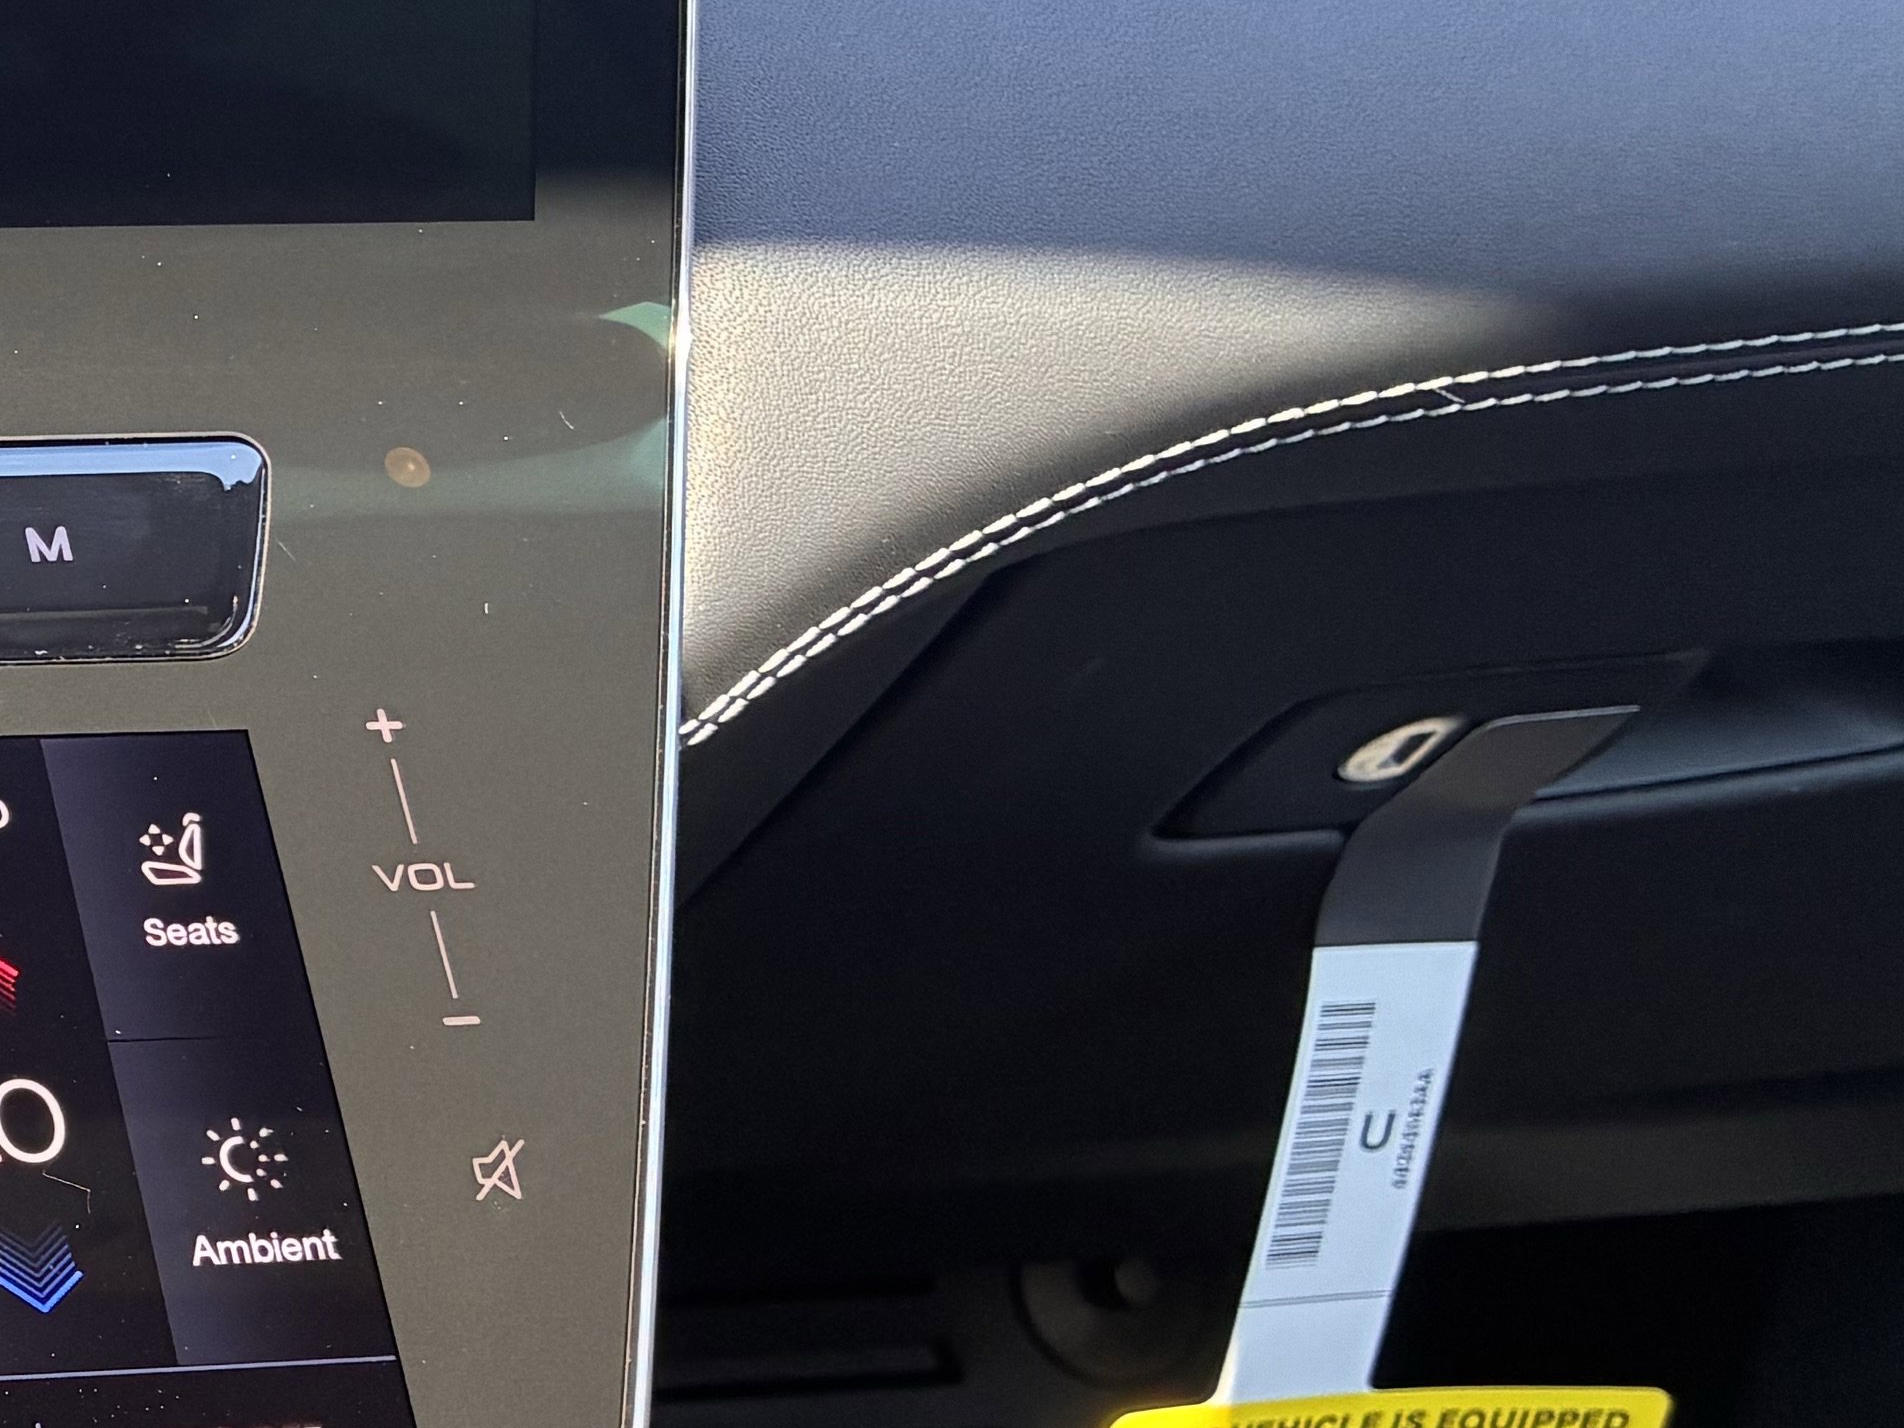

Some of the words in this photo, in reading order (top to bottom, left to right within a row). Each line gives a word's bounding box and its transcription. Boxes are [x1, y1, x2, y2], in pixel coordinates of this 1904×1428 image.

[24, 525, 74, 563] M
[371, 862, 475, 892] VOL
[143, 915, 240, 947] Seats
[192, 1228, 342, 1267] Ambient
